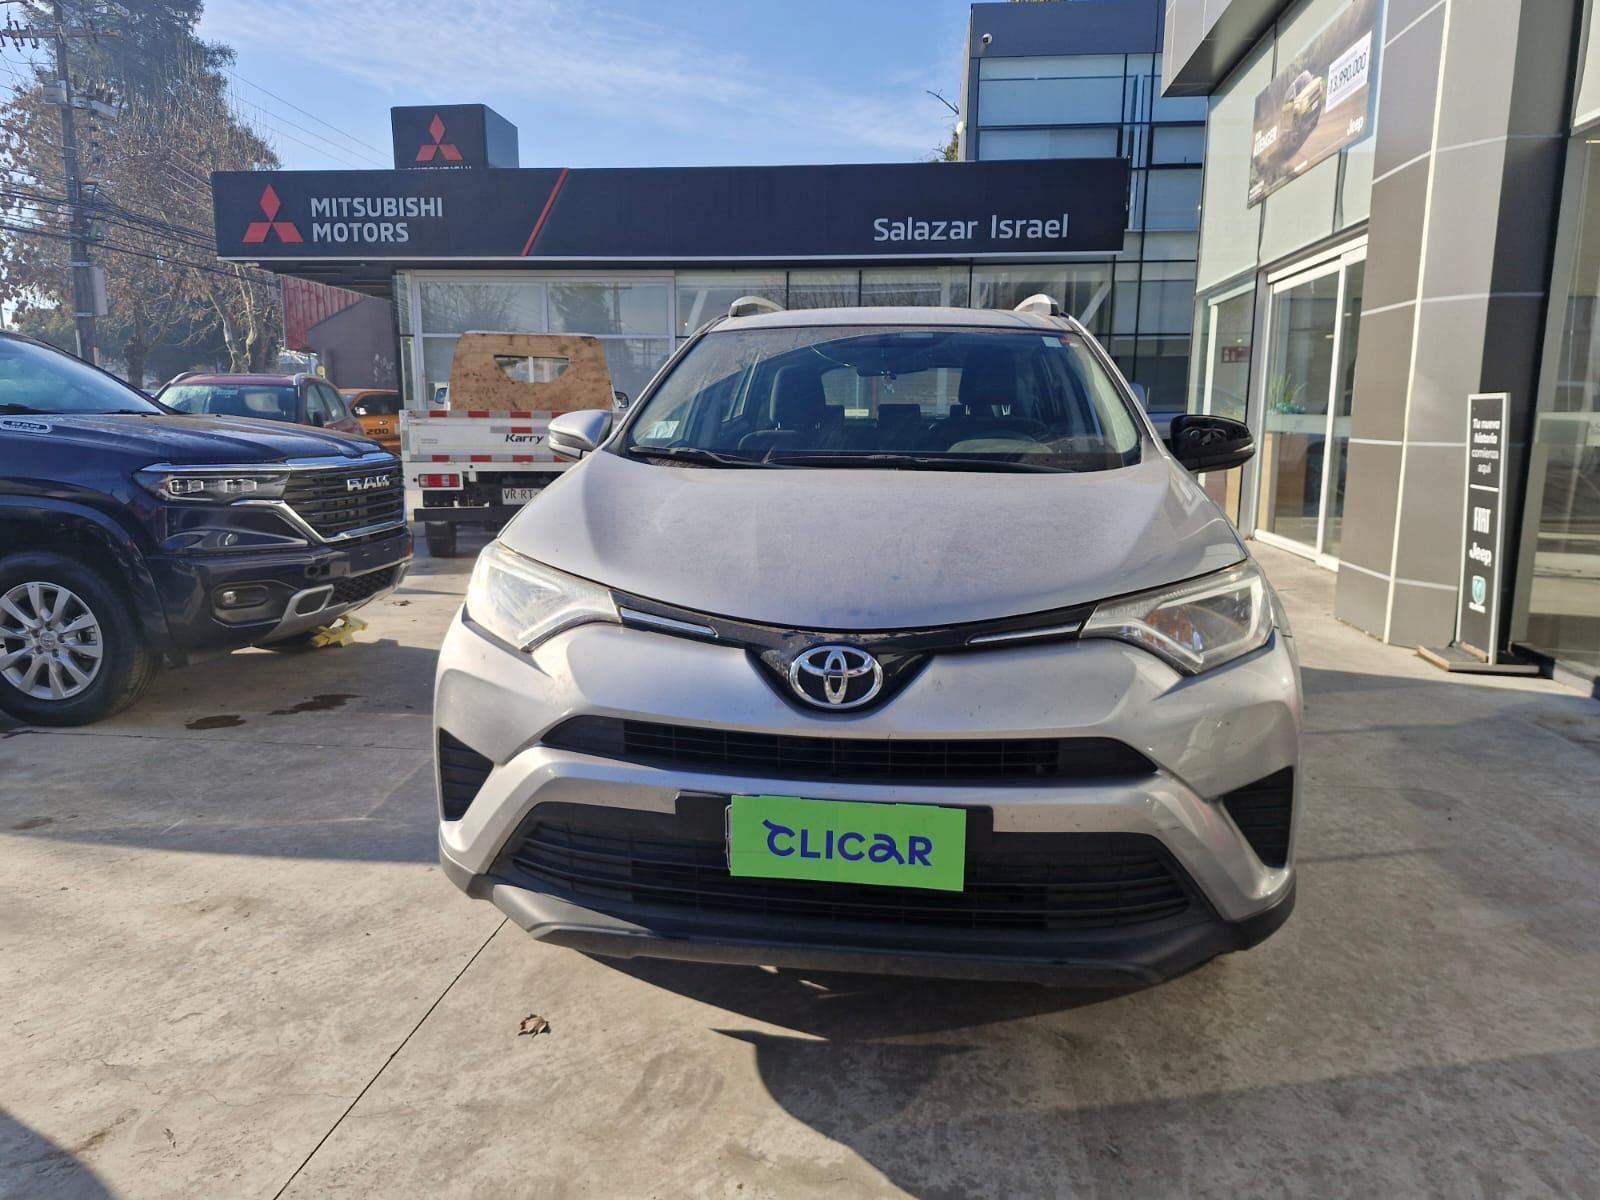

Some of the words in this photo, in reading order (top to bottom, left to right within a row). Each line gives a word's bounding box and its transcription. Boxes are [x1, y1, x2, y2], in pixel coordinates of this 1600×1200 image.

[310, 196, 443, 218] MITSUBISHI
[312, 222, 409, 243] MOTORS
[873, 216, 978, 241] Salazar
[990, 213, 1069, 239] Israel
[505, 434, 544, 444] Karry
[1469, 541, 1492, 566] Jeep
